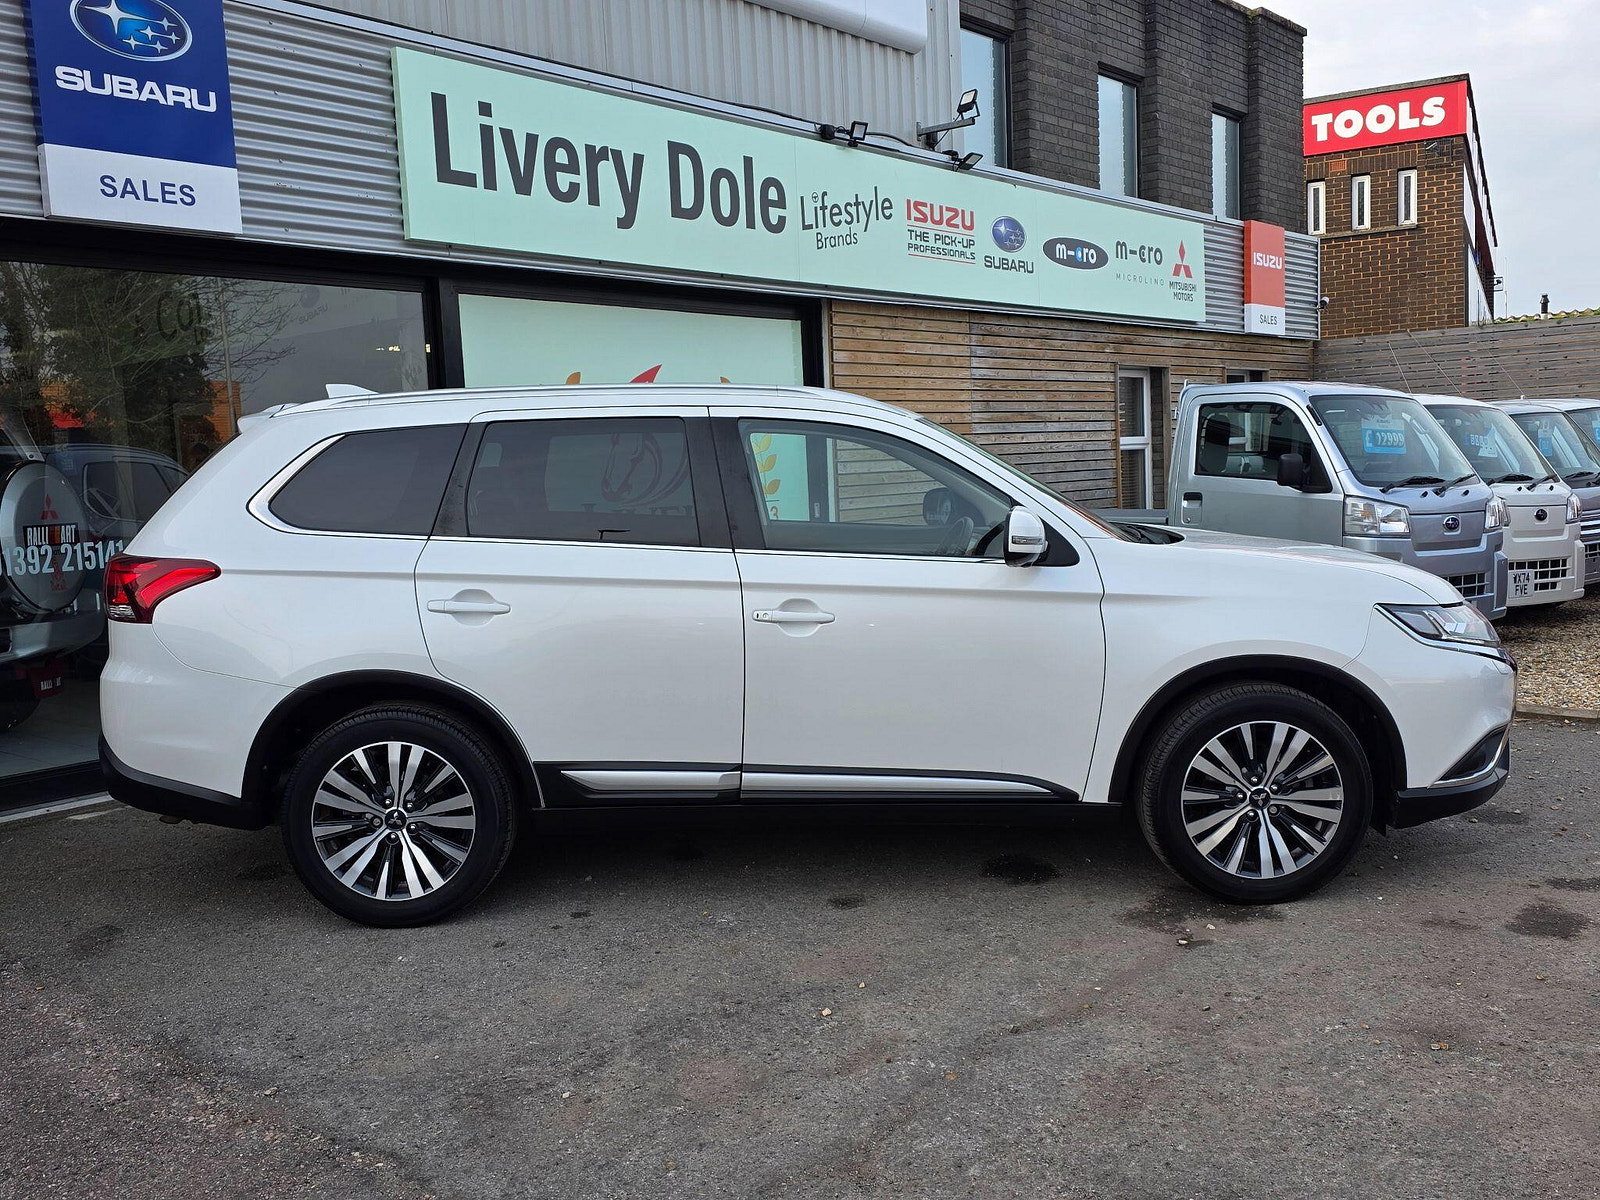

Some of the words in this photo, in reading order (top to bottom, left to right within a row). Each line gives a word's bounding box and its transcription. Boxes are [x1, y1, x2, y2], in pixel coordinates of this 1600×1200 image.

[55, 65, 217, 113] SUBARU
[1311, 96, 1446, 142] TOOLS
[430, 91, 645, 230] Livery
[667, 140, 787, 234] Dole
[99, 174, 197, 207] SALES
[800, 185, 894, 232] Lifestyle
[906, 198, 975, 231] ISUZU
[816, 227, 859, 250] Brands
[907, 229, 931, 243] THE
[934, 231, 975, 249] PICK-UP
[907, 243, 976, 260] PROFESSIONALS
[1253, 252, 1283, 270] ISUZU
[984, 255, 1034, 274] SUBARU
[1115, 273, 1165, 286] MICROLINO
[1169, 281, 1197, 292] MITSUBISHI
[1173, 291, 1194, 302] MOTORS
[1259, 313, 1278, 326] SALES
[27, 526, 49, 546] RALLI
[60, 524, 76, 543] ART
[0, 545, 55, 576] 1392
